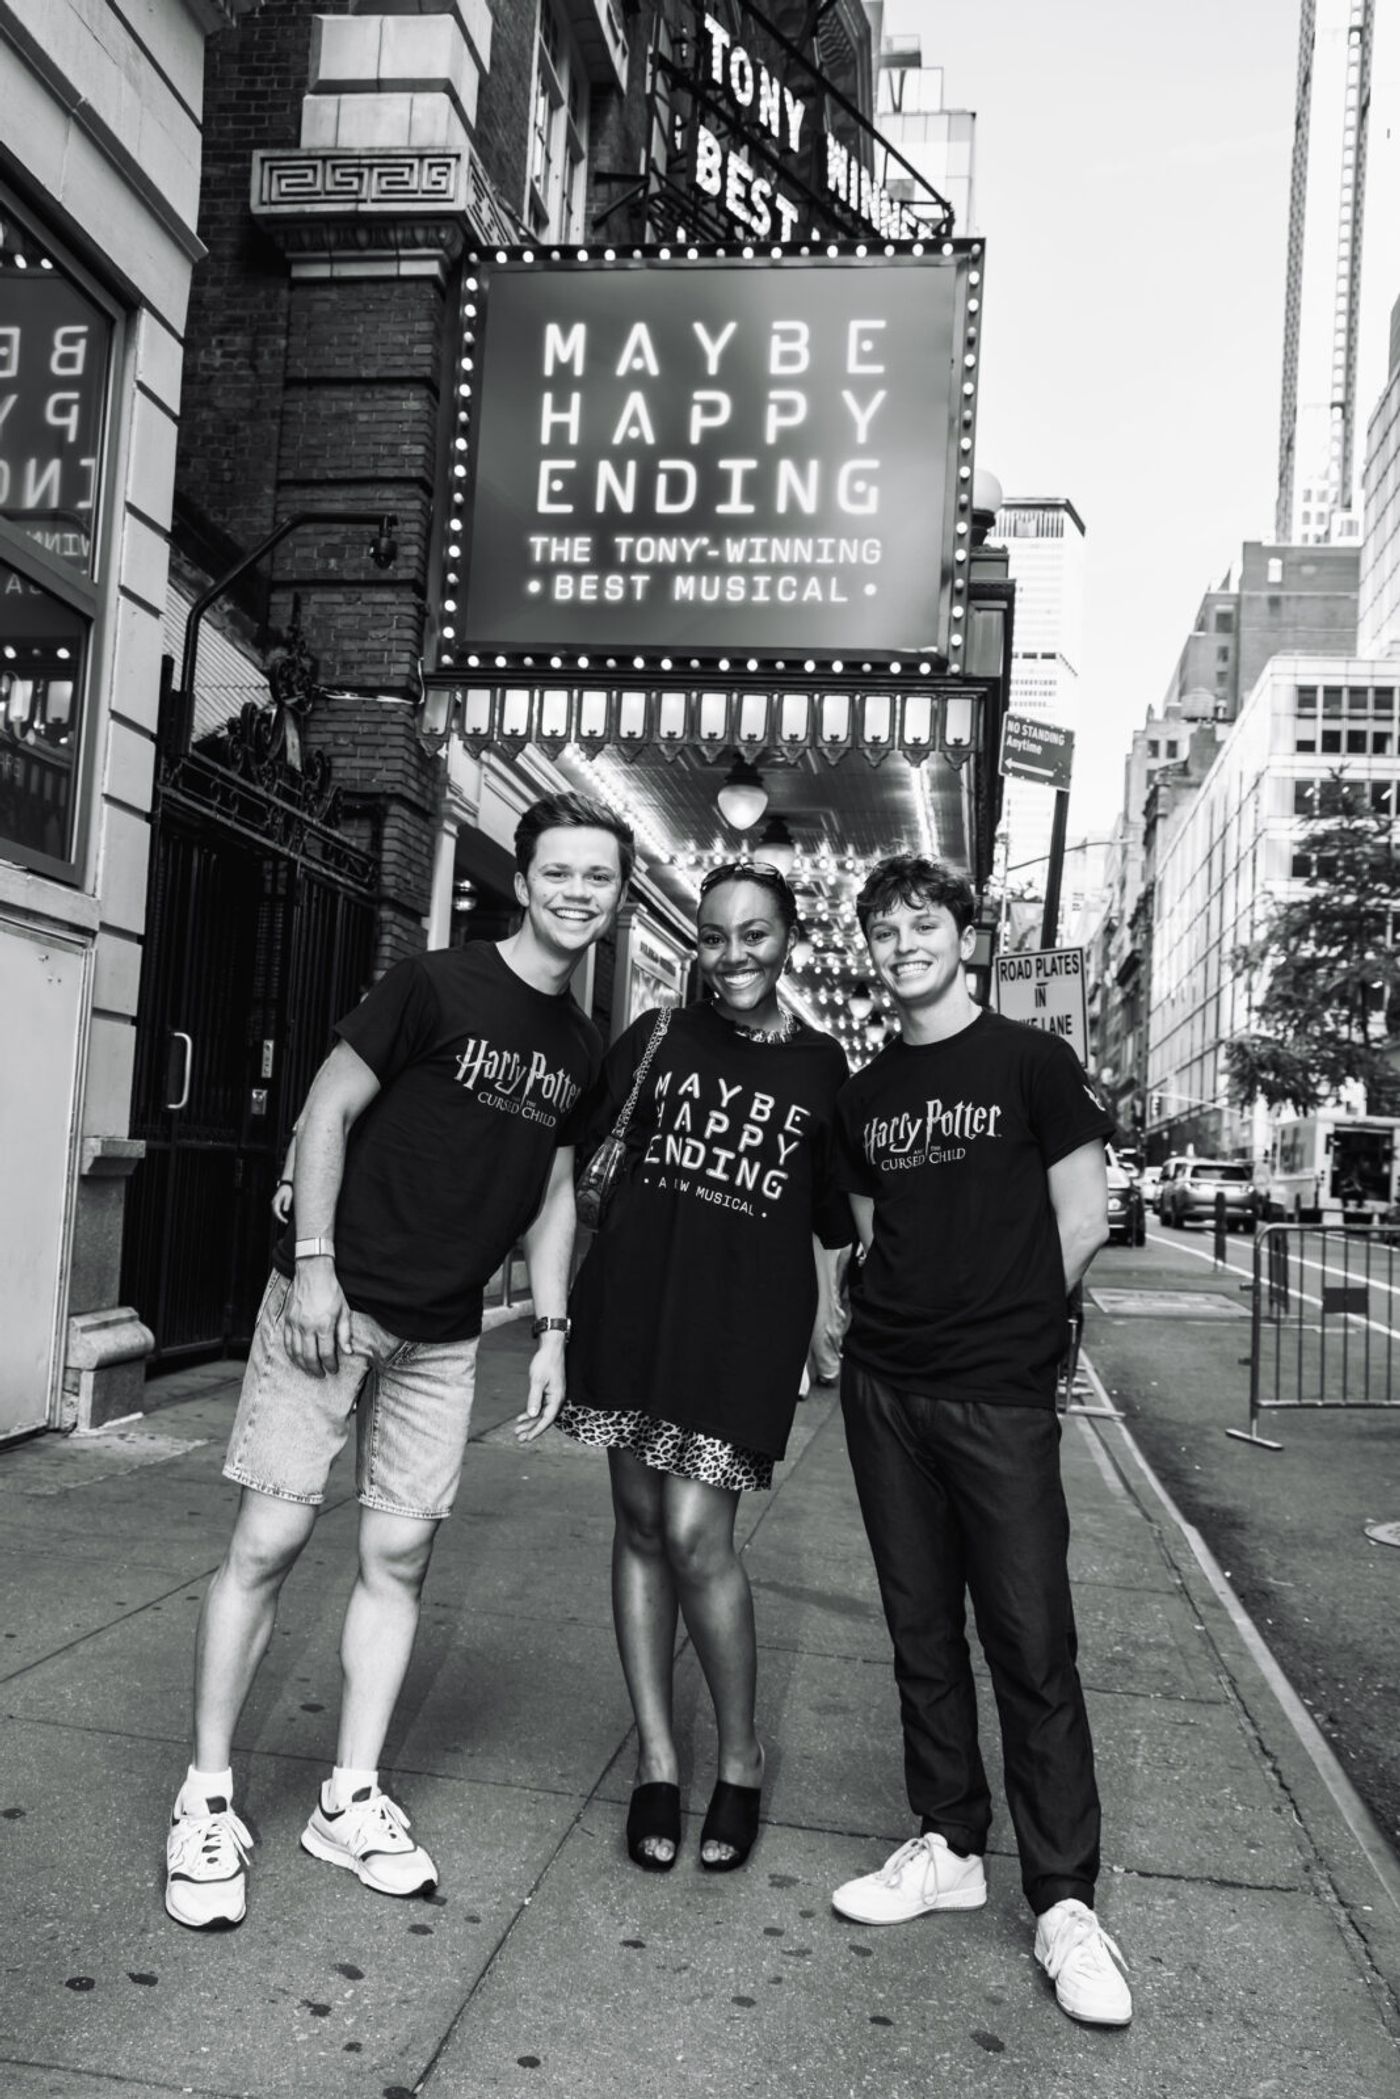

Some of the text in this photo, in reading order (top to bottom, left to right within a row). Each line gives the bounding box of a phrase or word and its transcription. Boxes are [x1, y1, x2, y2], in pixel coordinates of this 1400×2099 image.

[704, 13, 806, 153] TONY
[696, 124, 798, 243] BEST
[543, 319, 888, 377] MAYBE
[540, 388, 888, 446] HAPPY
[536, 458, 882, 516] ENDING
[529, 536, 592, 563] THE
[554, 574, 849, 603] BEST MUSICAL
[1006, 734, 1043, 756] Anytime
[1007, 719, 1066, 747] NO STANDING
[1000, 953, 1080, 982] ROAD PLATES
[1034, 987, 1047, 1009] IN
[454, 1037, 528, 1095] Harry
[477, 1091, 557, 1128] CURSED CHILD
[655, 1071, 811, 1136] MAYBE
[863, 1098, 1002, 1166] Harry Potter
[643, 1133, 788, 1200] ENDING
[881, 1147, 966, 1172] CURSED CHILD
[695, 1185, 755, 1217] MUSICAL
